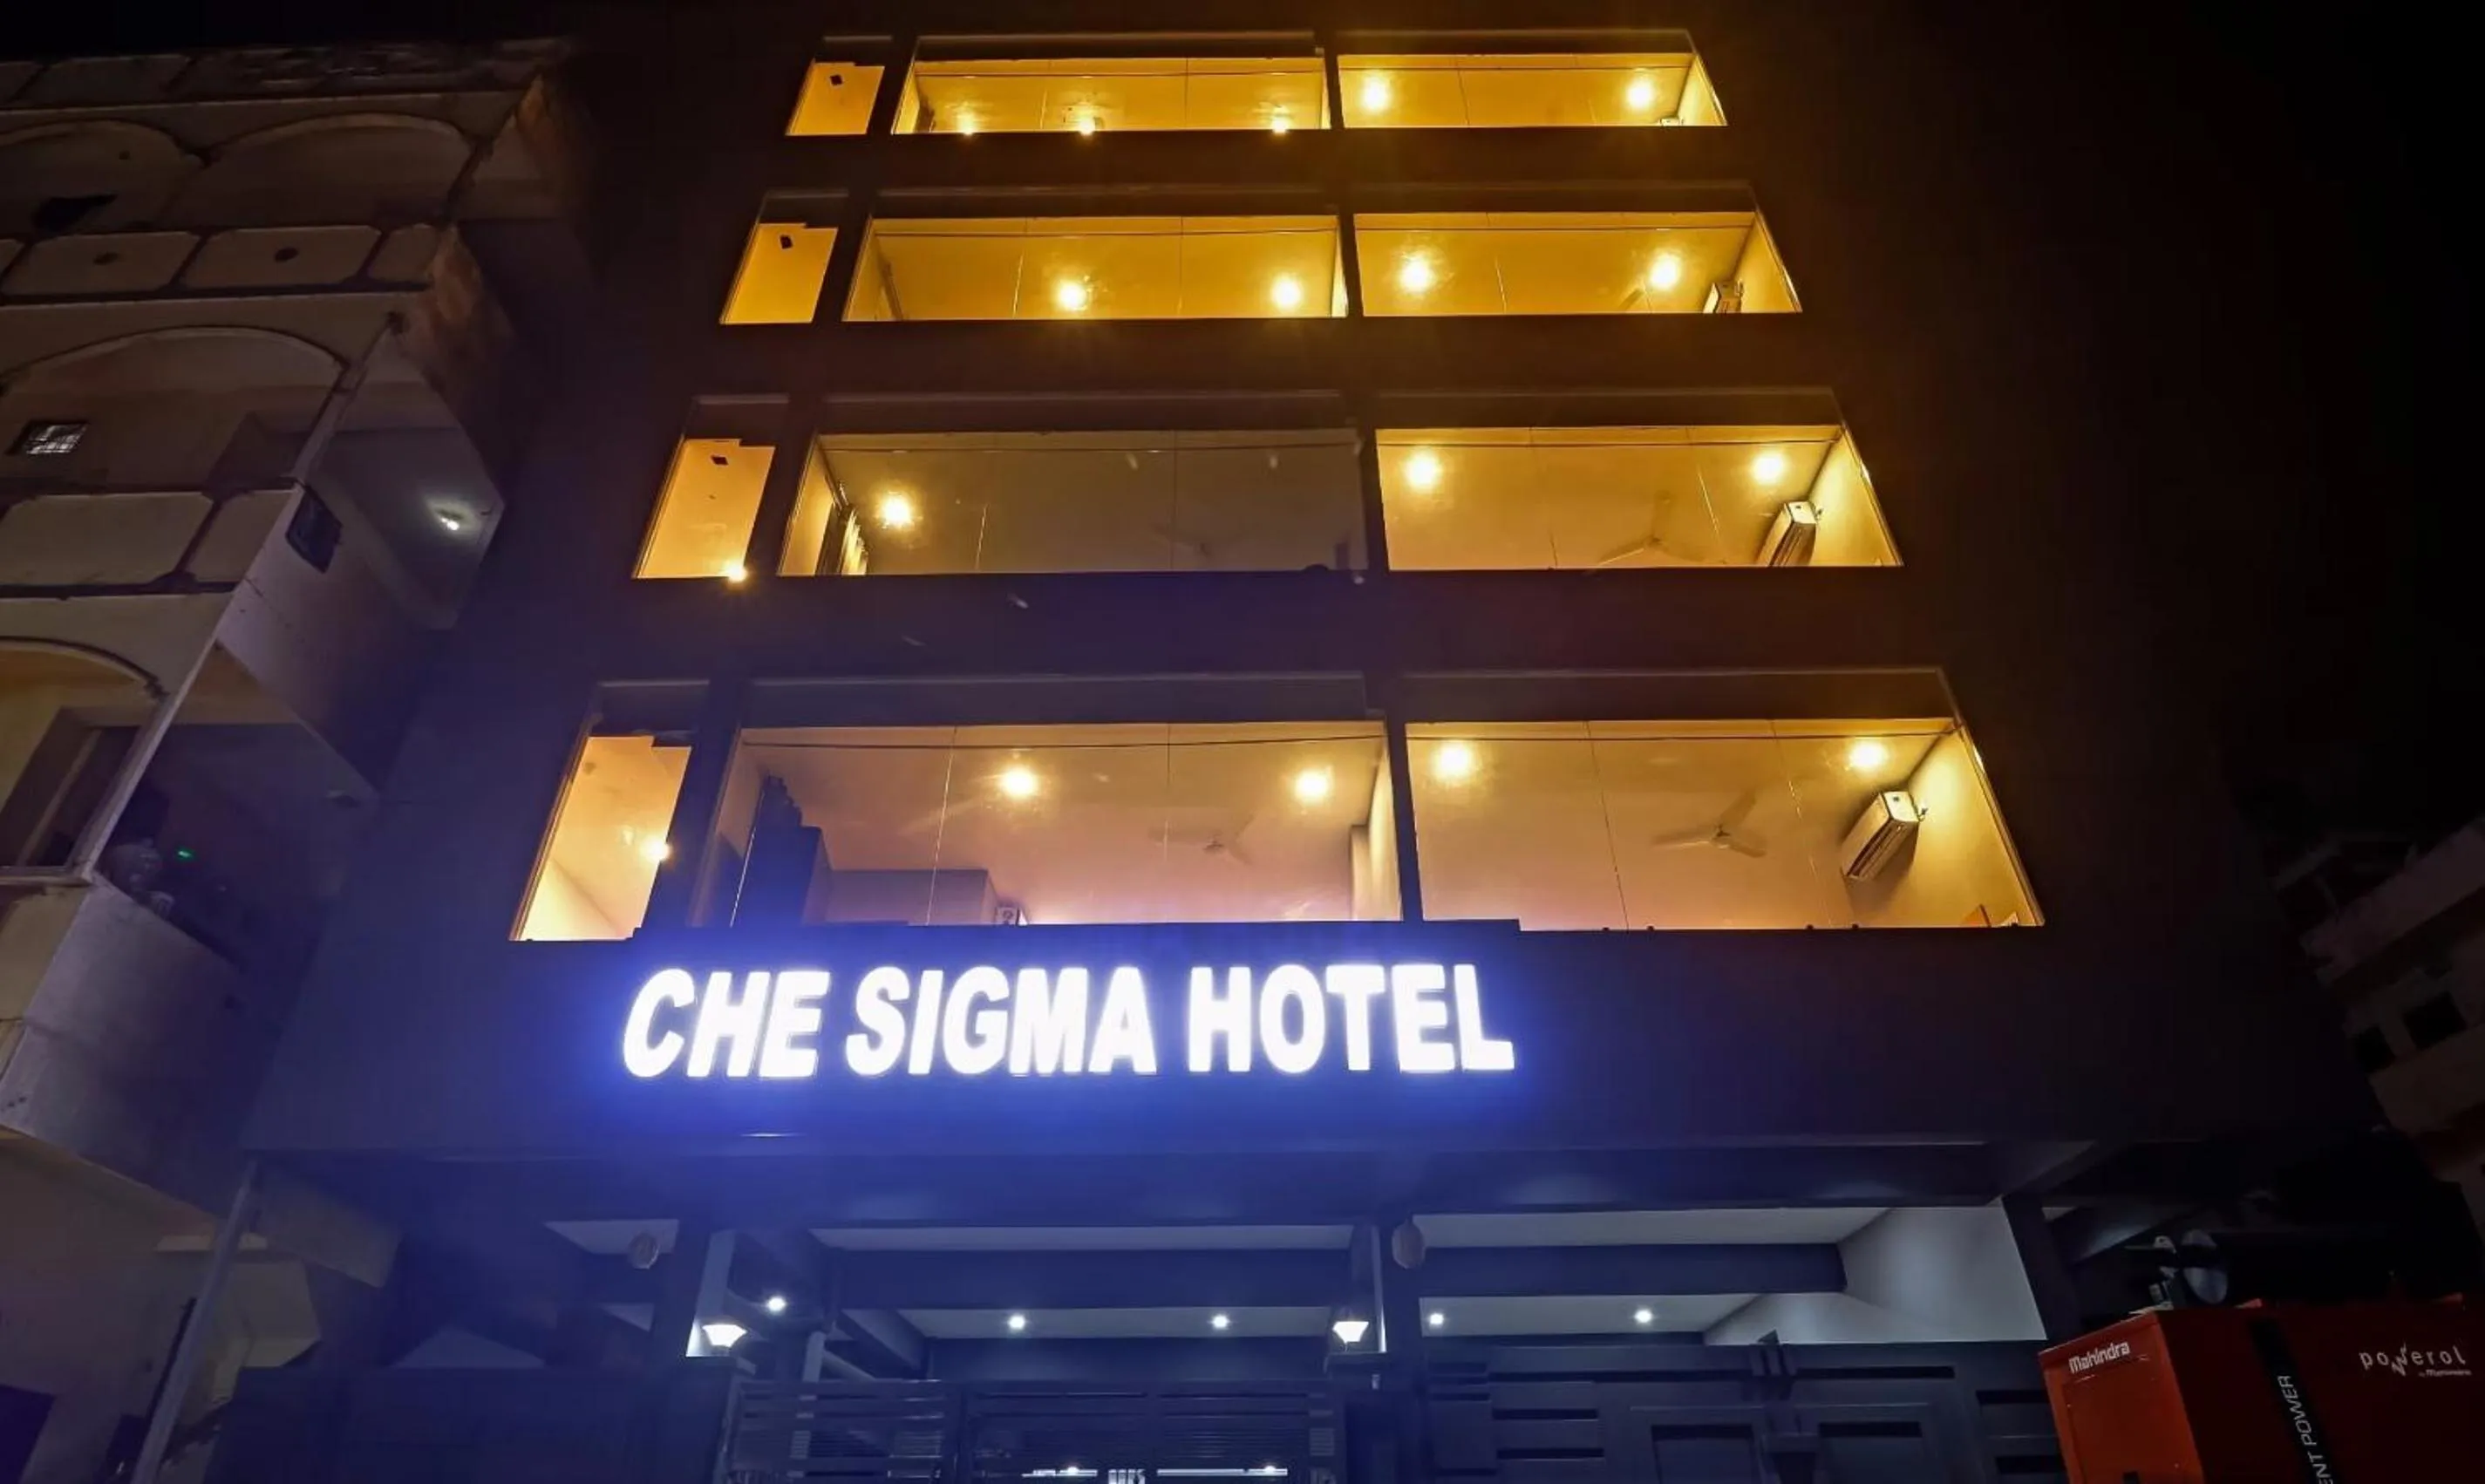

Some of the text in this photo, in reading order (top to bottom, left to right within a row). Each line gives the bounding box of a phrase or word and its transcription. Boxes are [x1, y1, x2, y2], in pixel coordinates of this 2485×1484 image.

[623, 963, 1515, 1079] CHE SIGMA HOTEL
[2068, 1342, 2130, 1373] Mahindra
[2277, 1376, 2317, 1445] POWER
